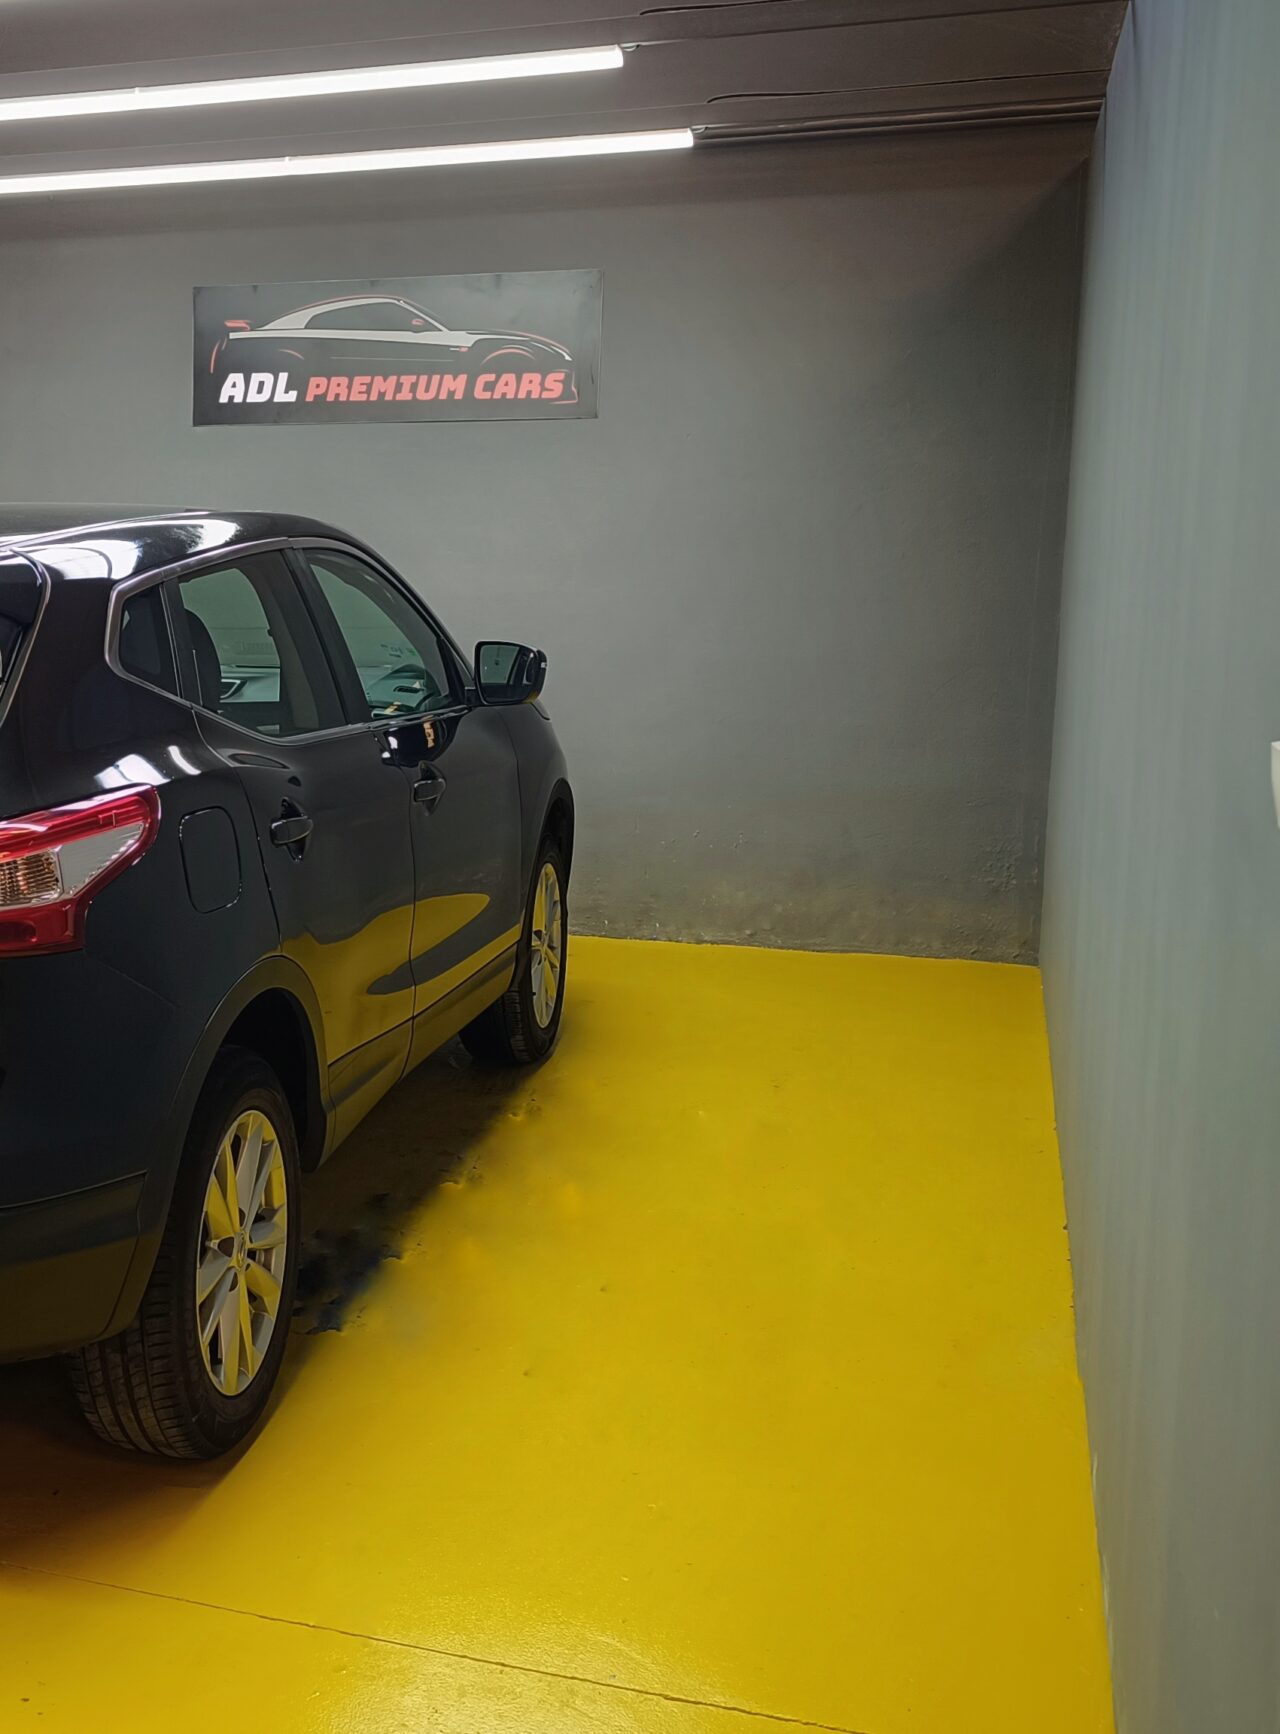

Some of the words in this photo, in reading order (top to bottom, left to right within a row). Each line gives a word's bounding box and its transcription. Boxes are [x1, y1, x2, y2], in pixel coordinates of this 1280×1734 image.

[219, 372, 298, 403] ADL
[305, 374, 467, 402] PREMIUM
[474, 372, 565, 400] CARS
